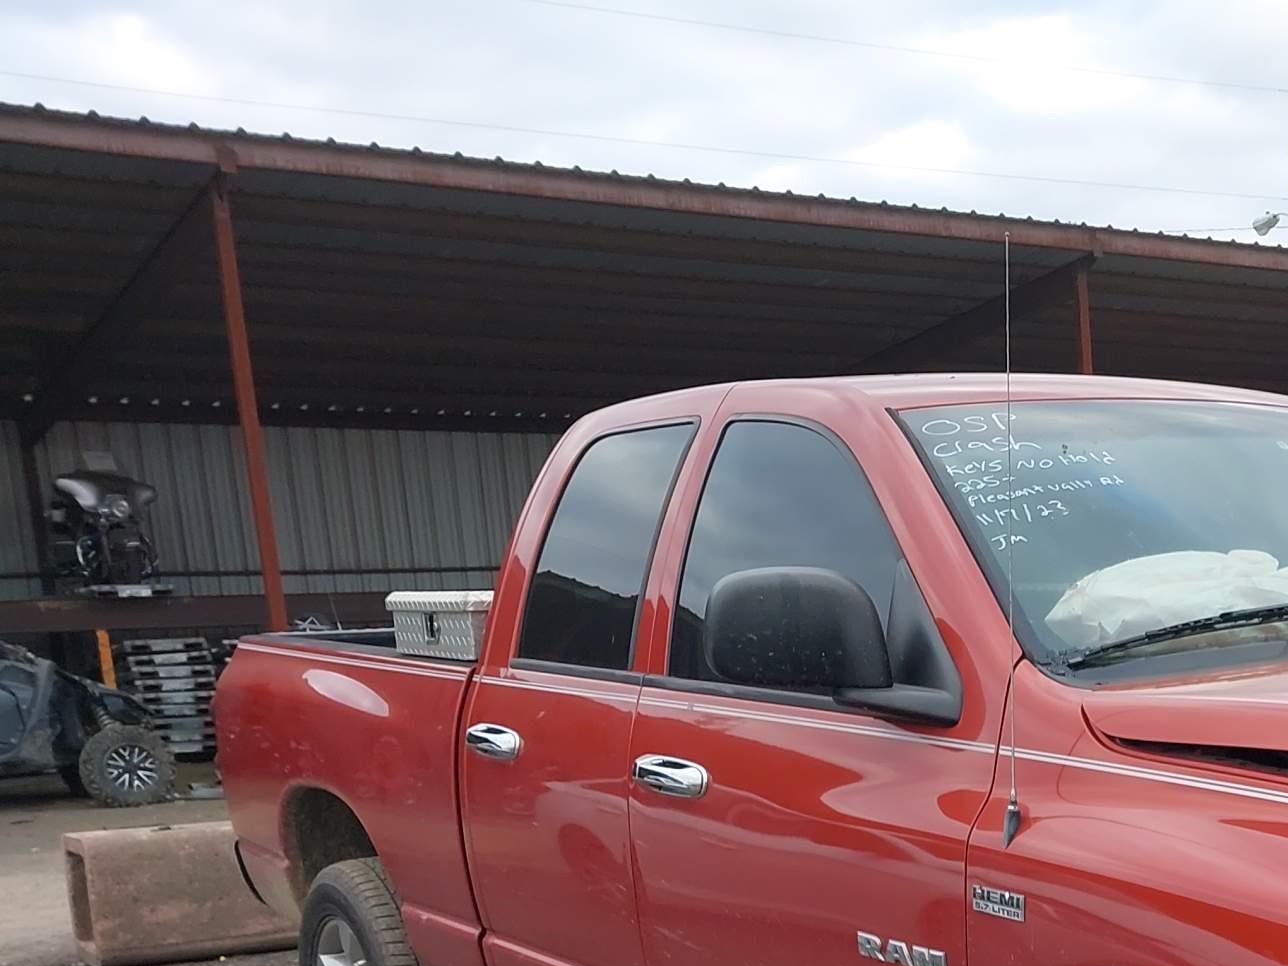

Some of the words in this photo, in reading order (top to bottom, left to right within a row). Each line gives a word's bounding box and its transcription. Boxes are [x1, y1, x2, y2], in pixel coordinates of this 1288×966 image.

[921, 413, 1017, 436] OSP
[972, 886, 1021, 910] HEMI
[975, 901, 989, 911] 5.7
[992, 905, 1020, 919] LITER
